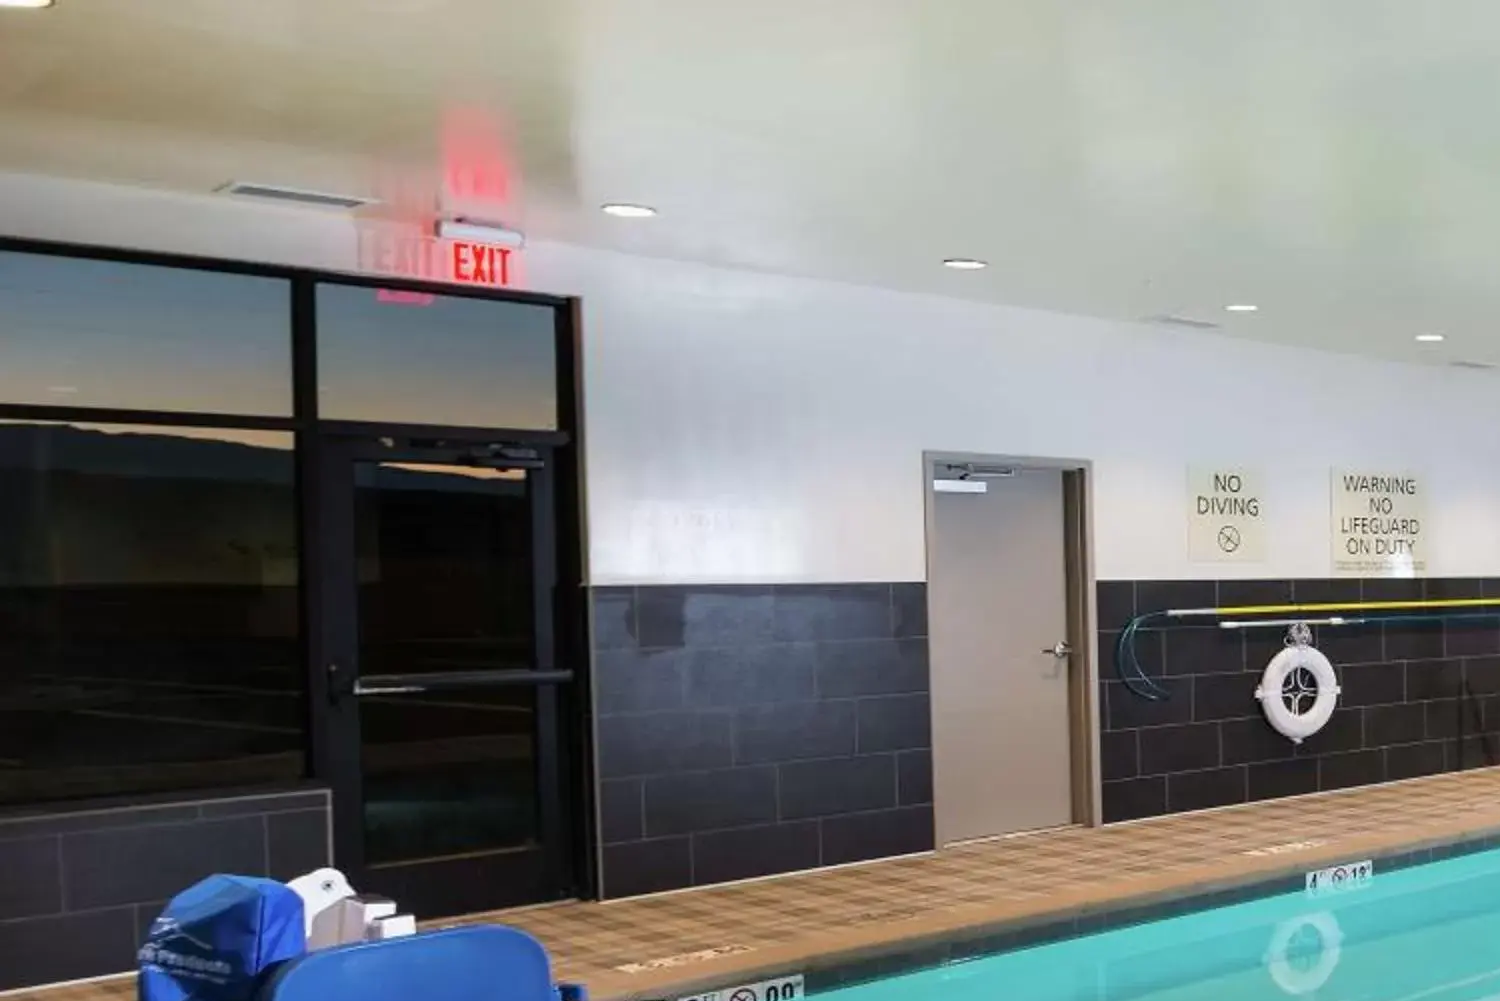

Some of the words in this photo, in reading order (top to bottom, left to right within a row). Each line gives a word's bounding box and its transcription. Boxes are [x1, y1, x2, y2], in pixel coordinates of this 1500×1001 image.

[453, 242, 511, 284] EXIT
[1214, 474, 1241, 493] NO
[1343, 475, 1416, 494] WARNING
[1197, 496, 1258, 517] DIVING
[1369, 497, 1392, 515] NO
[1341, 517, 1420, 535] LIFEGUARD
[1347, 538, 1369, 555] ON
[1376, 539, 1415, 555] DUTY
